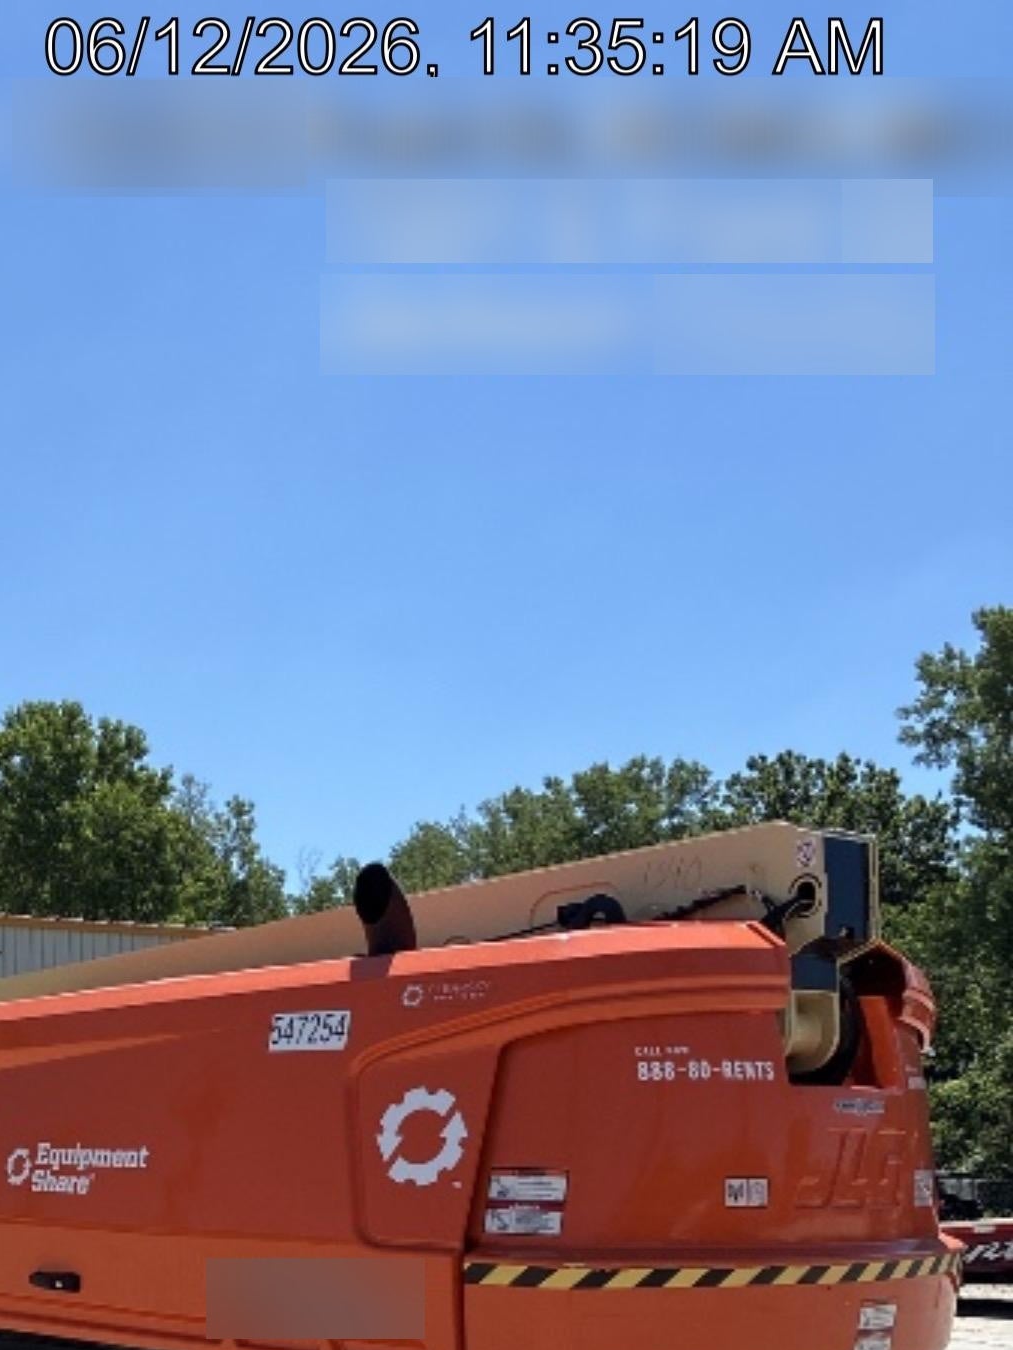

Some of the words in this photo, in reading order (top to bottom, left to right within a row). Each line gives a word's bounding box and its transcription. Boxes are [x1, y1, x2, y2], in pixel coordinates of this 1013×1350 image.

[271, 1013, 347, 1044] 547254
[36, 1142, 149, 1170] Equipment
[31, 1169, 90, 1195] Share
